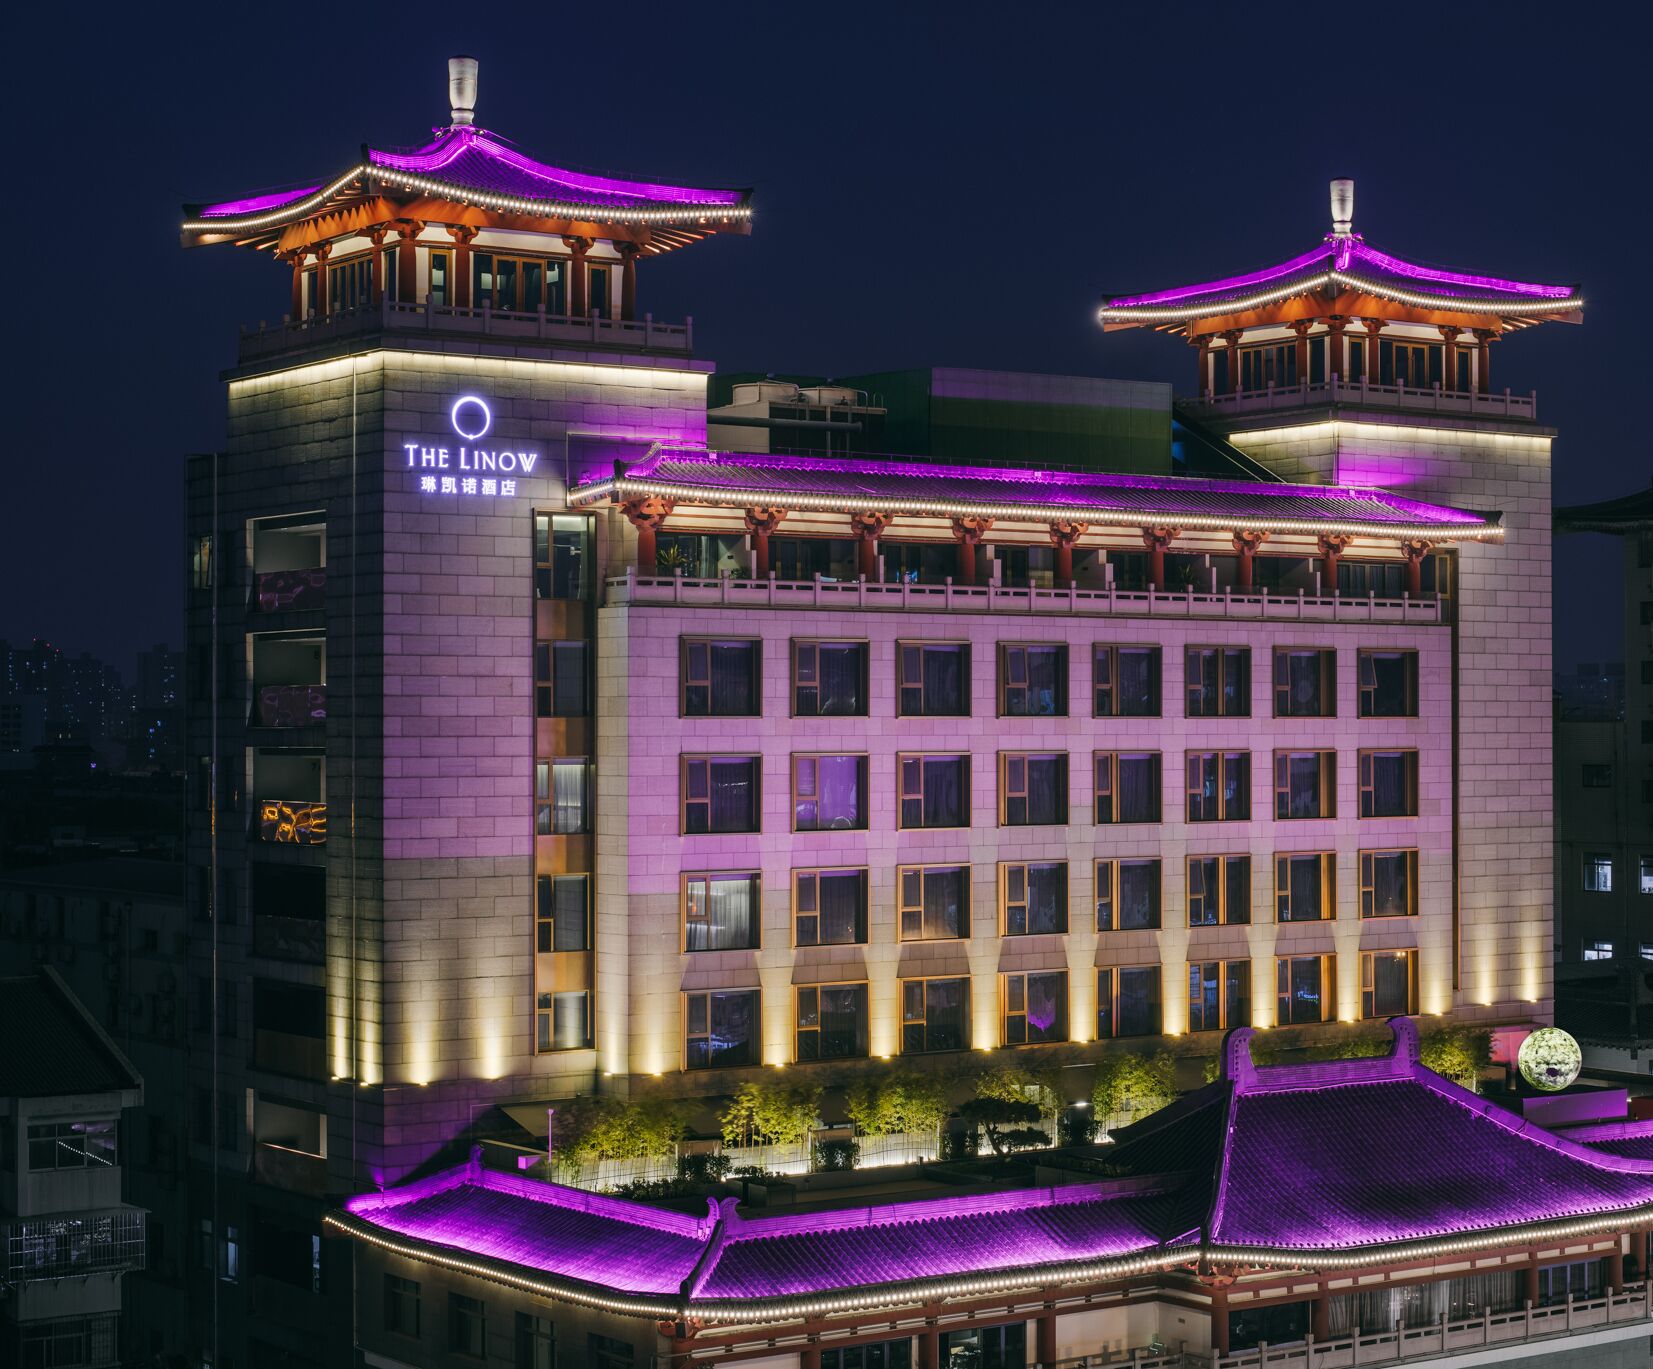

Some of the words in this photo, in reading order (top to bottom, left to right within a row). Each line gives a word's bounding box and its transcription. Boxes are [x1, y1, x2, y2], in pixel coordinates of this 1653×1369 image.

[404, 444, 449, 468] THE
[460, 447, 538, 473] LINOW
[420, 475, 516, 496] 琳凯诺酒店
